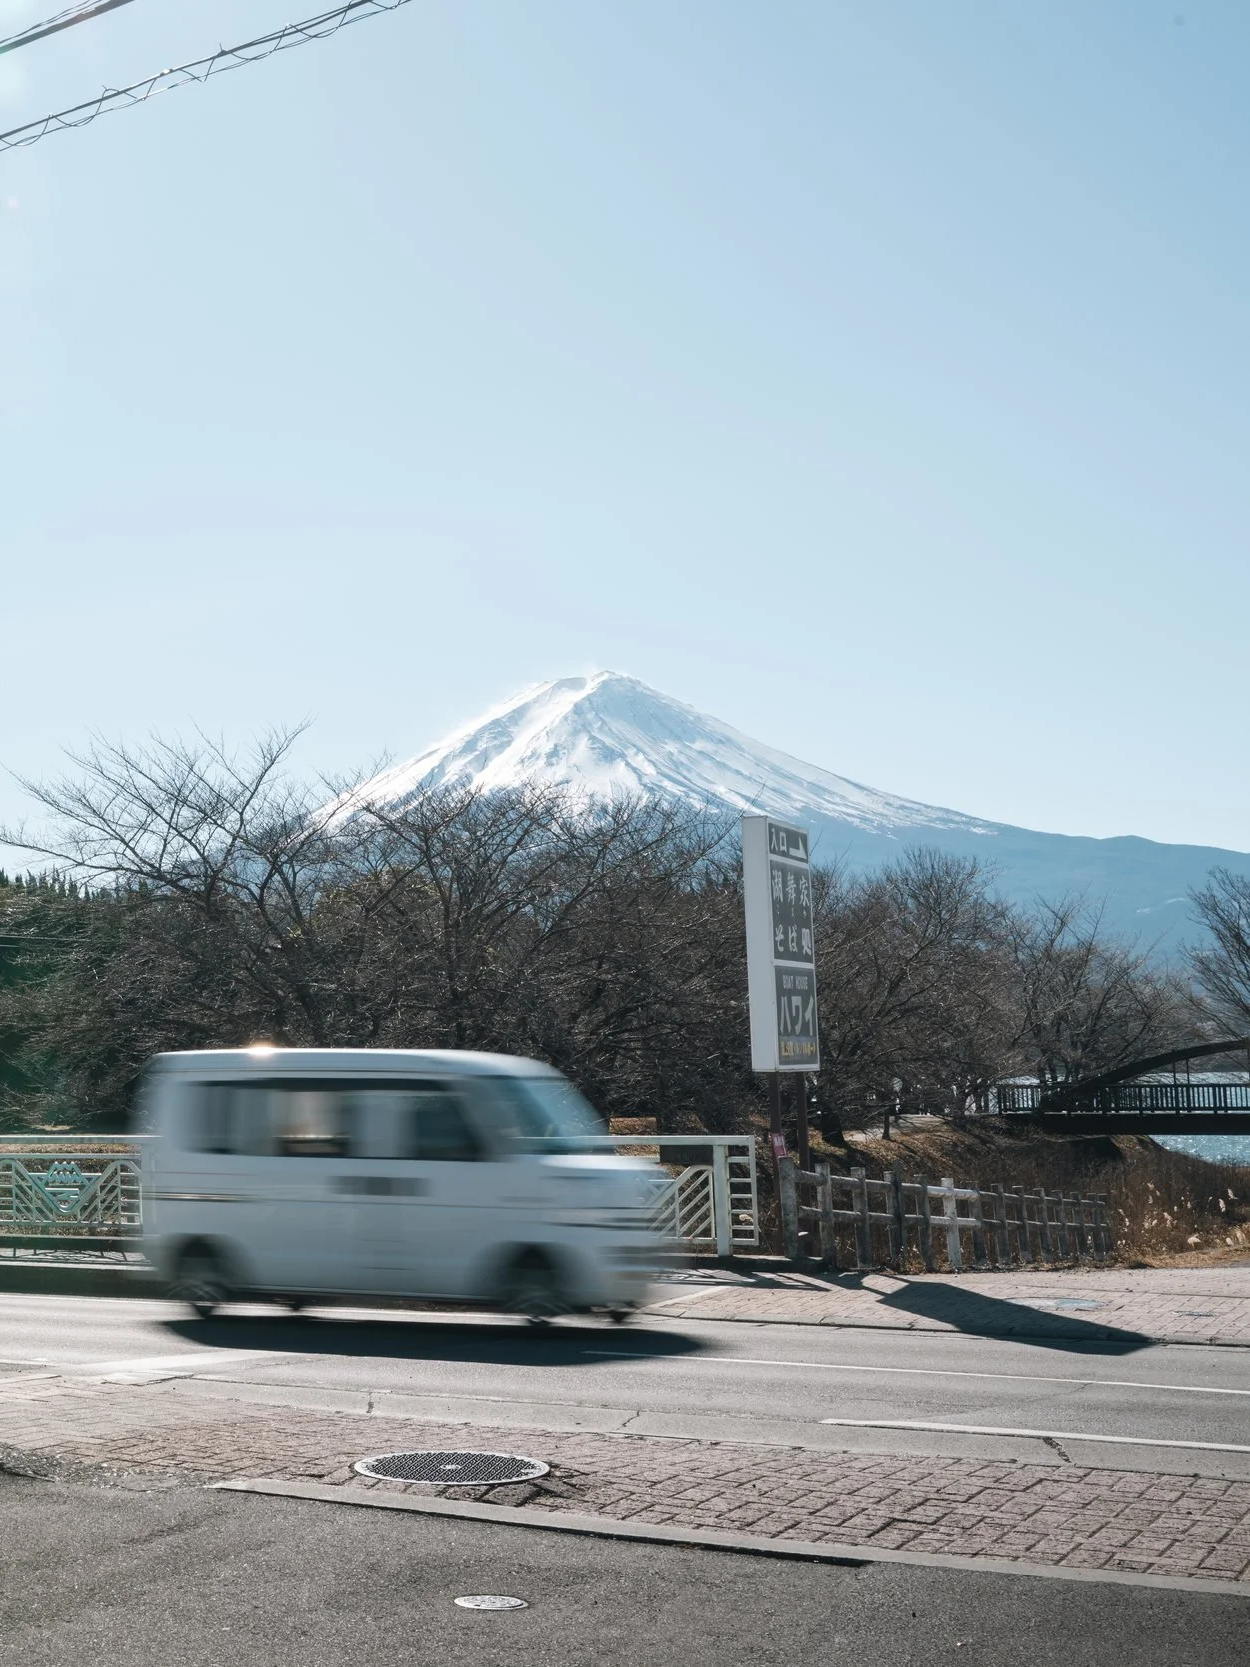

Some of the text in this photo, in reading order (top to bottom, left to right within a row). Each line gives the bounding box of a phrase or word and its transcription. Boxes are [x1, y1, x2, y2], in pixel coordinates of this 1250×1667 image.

[770, 828, 788, 853] 入口
[779, 994, 815, 1037] ハワイ
